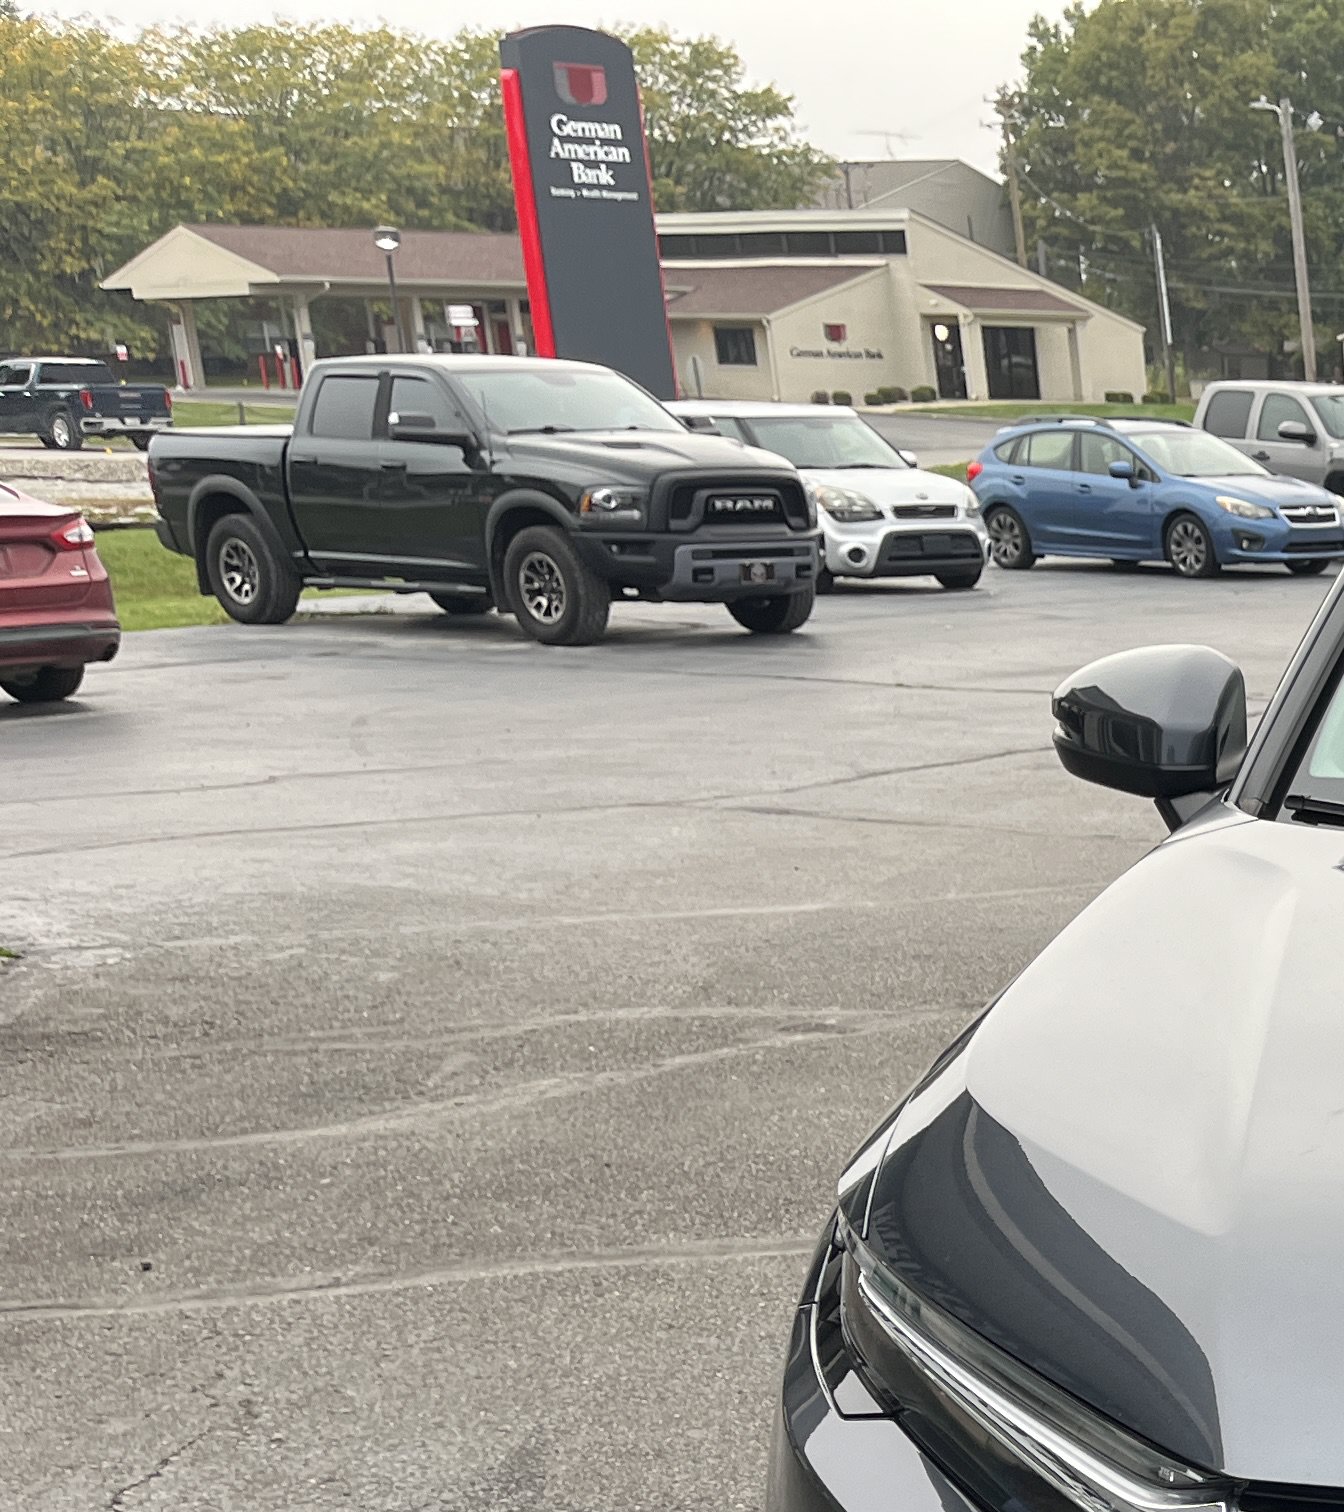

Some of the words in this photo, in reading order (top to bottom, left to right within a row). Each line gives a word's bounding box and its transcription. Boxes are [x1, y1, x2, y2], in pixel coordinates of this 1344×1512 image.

[549, 113, 623, 140] German
[549, 136, 631, 163] American
[570, 161, 616, 186] Bank
[789, 346, 824, 358] German
[713, 499, 774, 511] RAM
